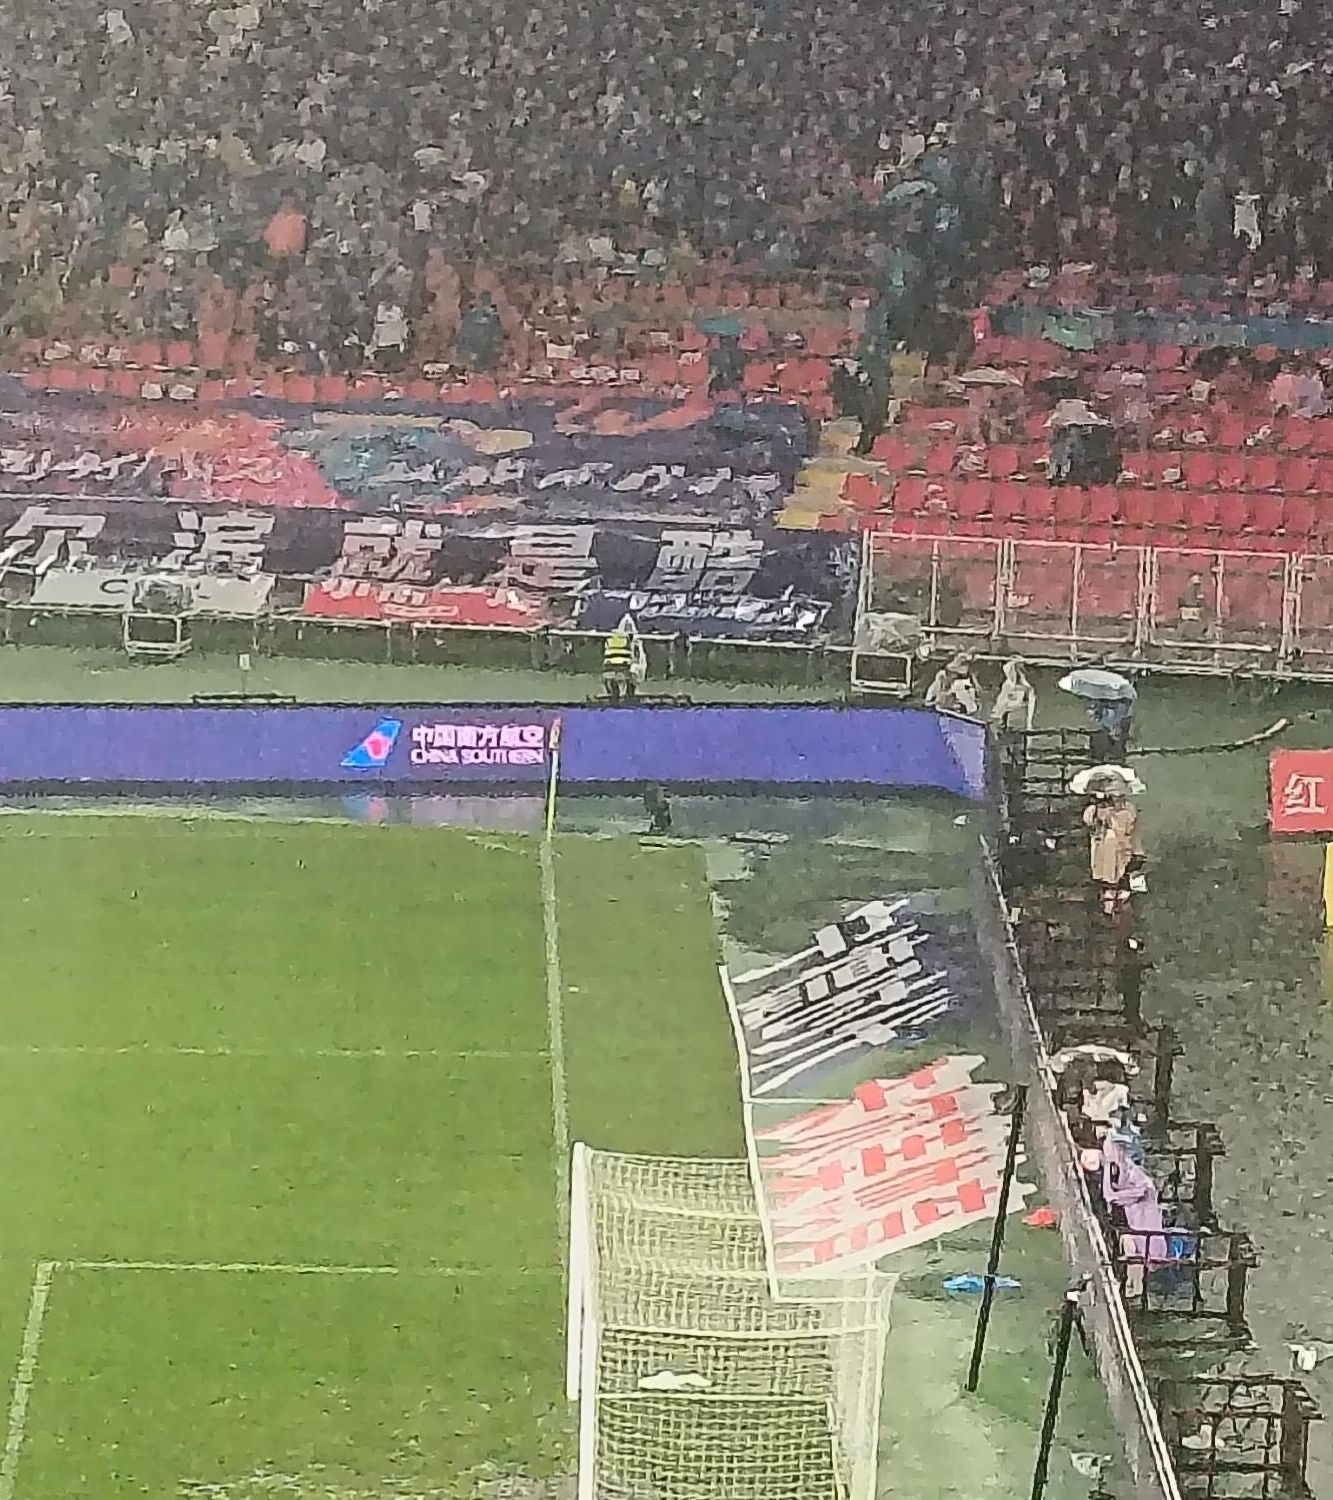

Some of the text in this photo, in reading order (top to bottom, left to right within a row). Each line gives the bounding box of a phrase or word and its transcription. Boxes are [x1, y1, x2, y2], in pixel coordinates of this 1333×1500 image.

[411, 724, 545, 748] 中国南方航空
[410, 748, 458, 763] CHINA
[1284, 773, 1327, 817] 红
[732, 898, 959, 1096] 宁德时代
